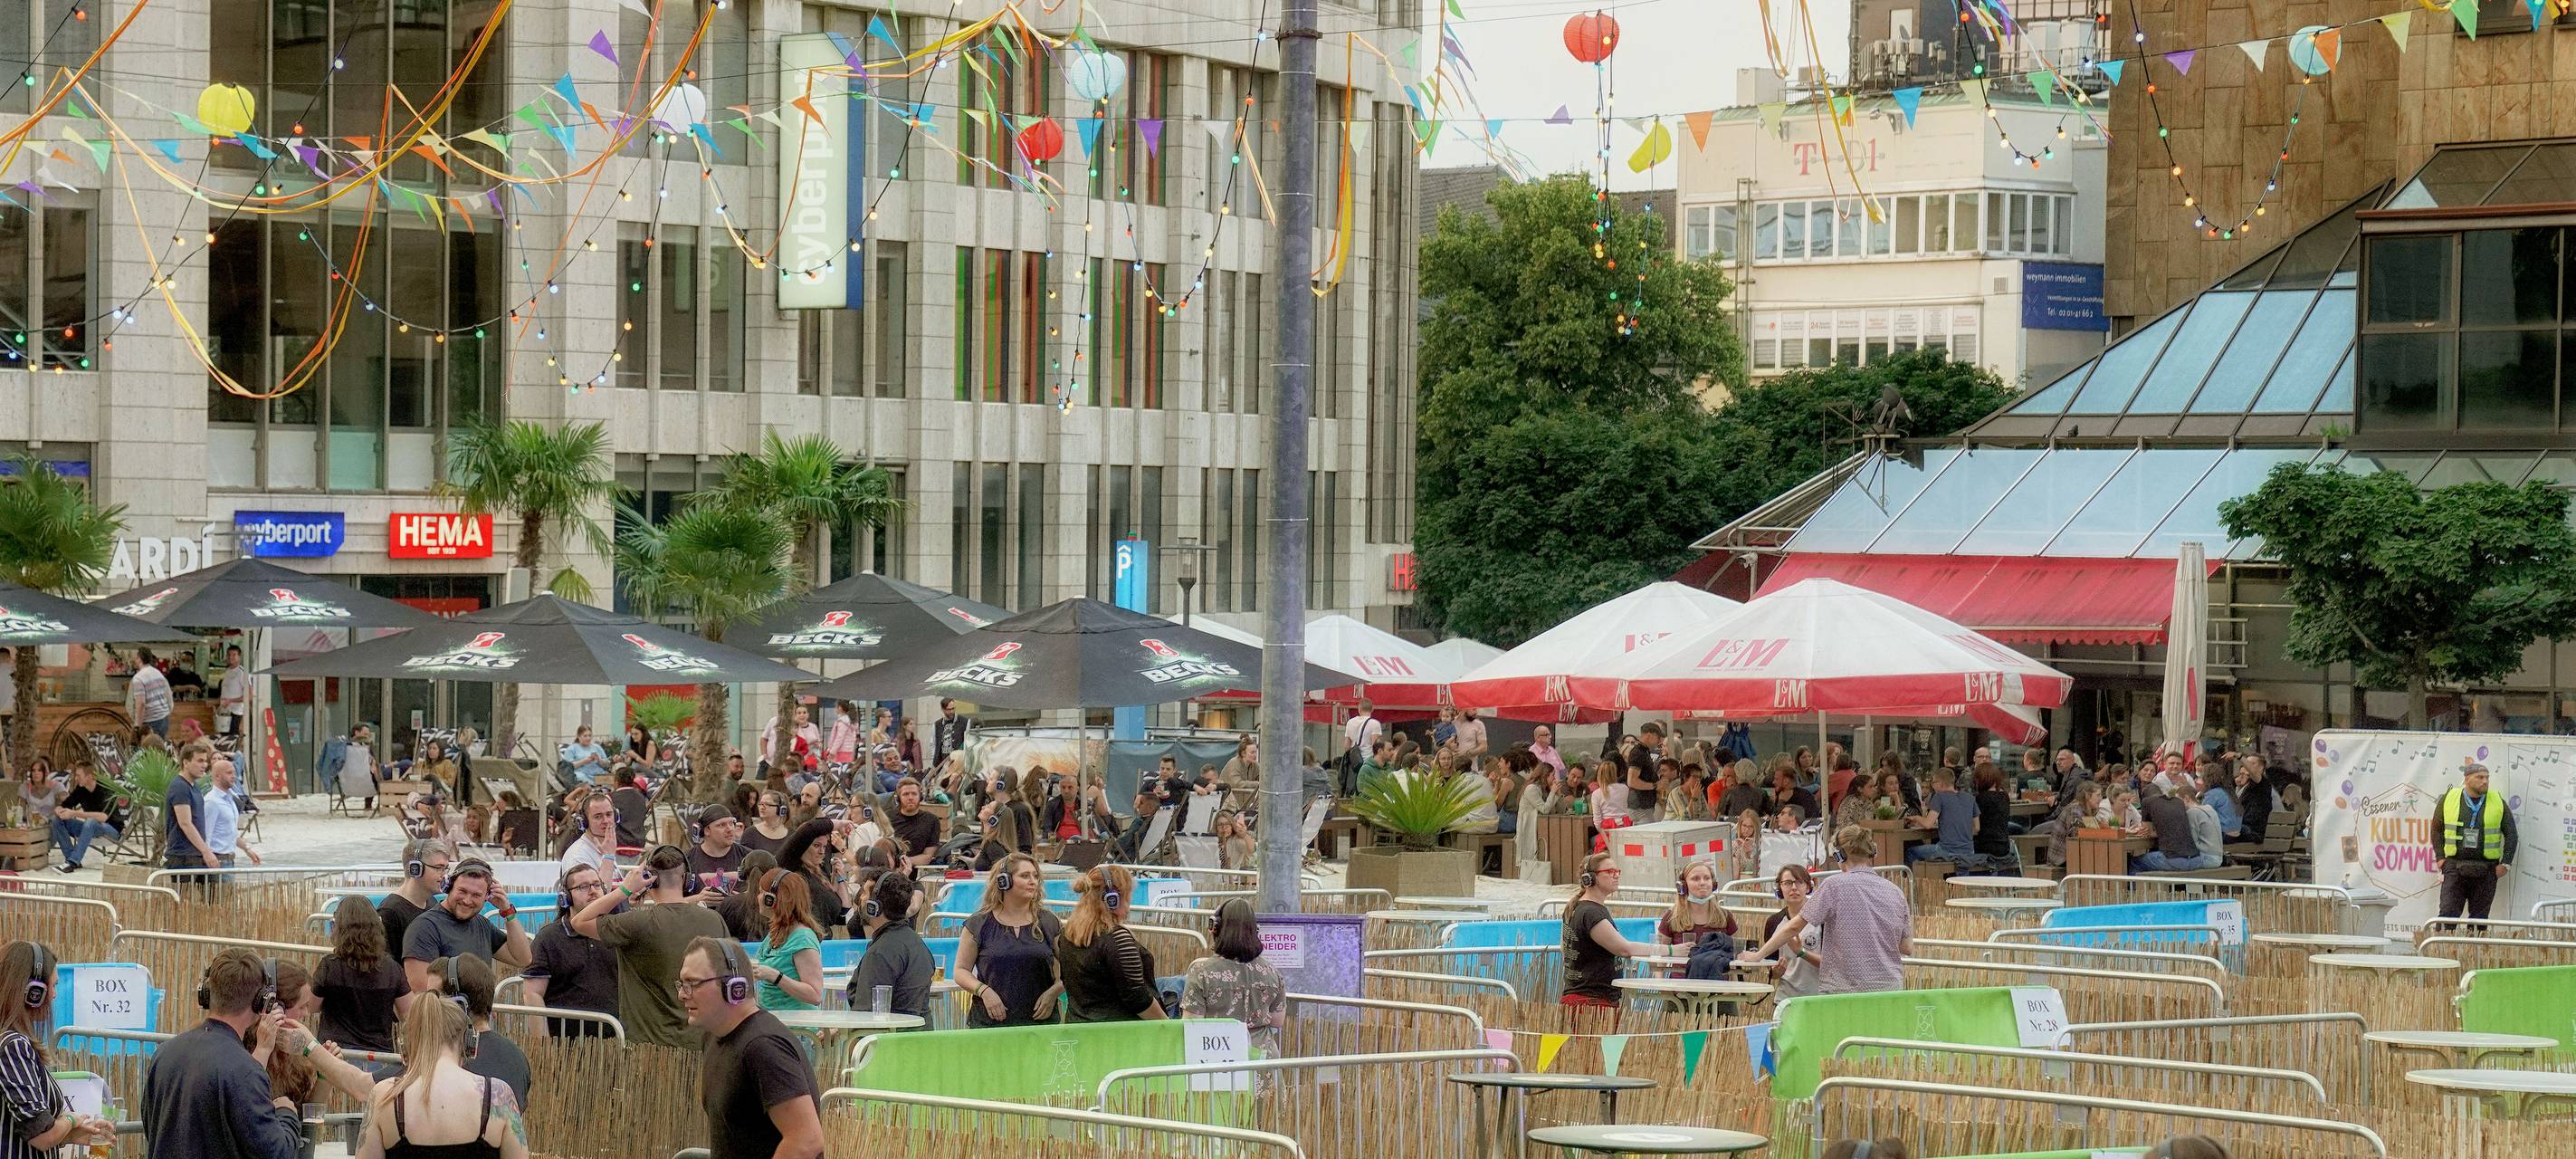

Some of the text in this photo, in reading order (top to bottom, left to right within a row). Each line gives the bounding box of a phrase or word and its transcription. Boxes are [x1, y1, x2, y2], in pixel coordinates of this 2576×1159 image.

[2026, 273, 2086, 283] weymann immobilien
[2047, 307, 2056, 316] Tel.
[400, 516, 483, 547] HEMA
[107, 522, 215, 580] ARDÍ
[0, 619, 70, 631] ECK'S
[768, 632, 883, 646] BECK'S
[1696, 638, 1790, 667] L&M
[1352, 656, 1415, 676] L&M
[923, 666, 1024, 687] BECK'S
[1544, 676, 1571, 702] L&M
[1774, 679, 1807, 707] L&M
[1965, 673, 1998, 702] L&M
[1559, 704, 1579, 722] L&M
[2361, 796, 2401, 817] Essener
[2371, 817, 2435, 845] KULTU
[2374, 844, 2438, 873] SOMME
[2217, 911, 2233, 921] BOX
[2383, 924, 2398, 932] ETS
[1259, 934, 1297, 942] LEKTRO
[1261, 943, 1297, 951] NEIDER
[95, 979, 128, 993] BOX
[91, 1000, 131, 1013] Nr. 32
[2027, 1000, 2050, 1013] BOX
[2029, 1019, 2059, 1032] Nr. 28
[1202, 1036, 1231, 1051] BOX
